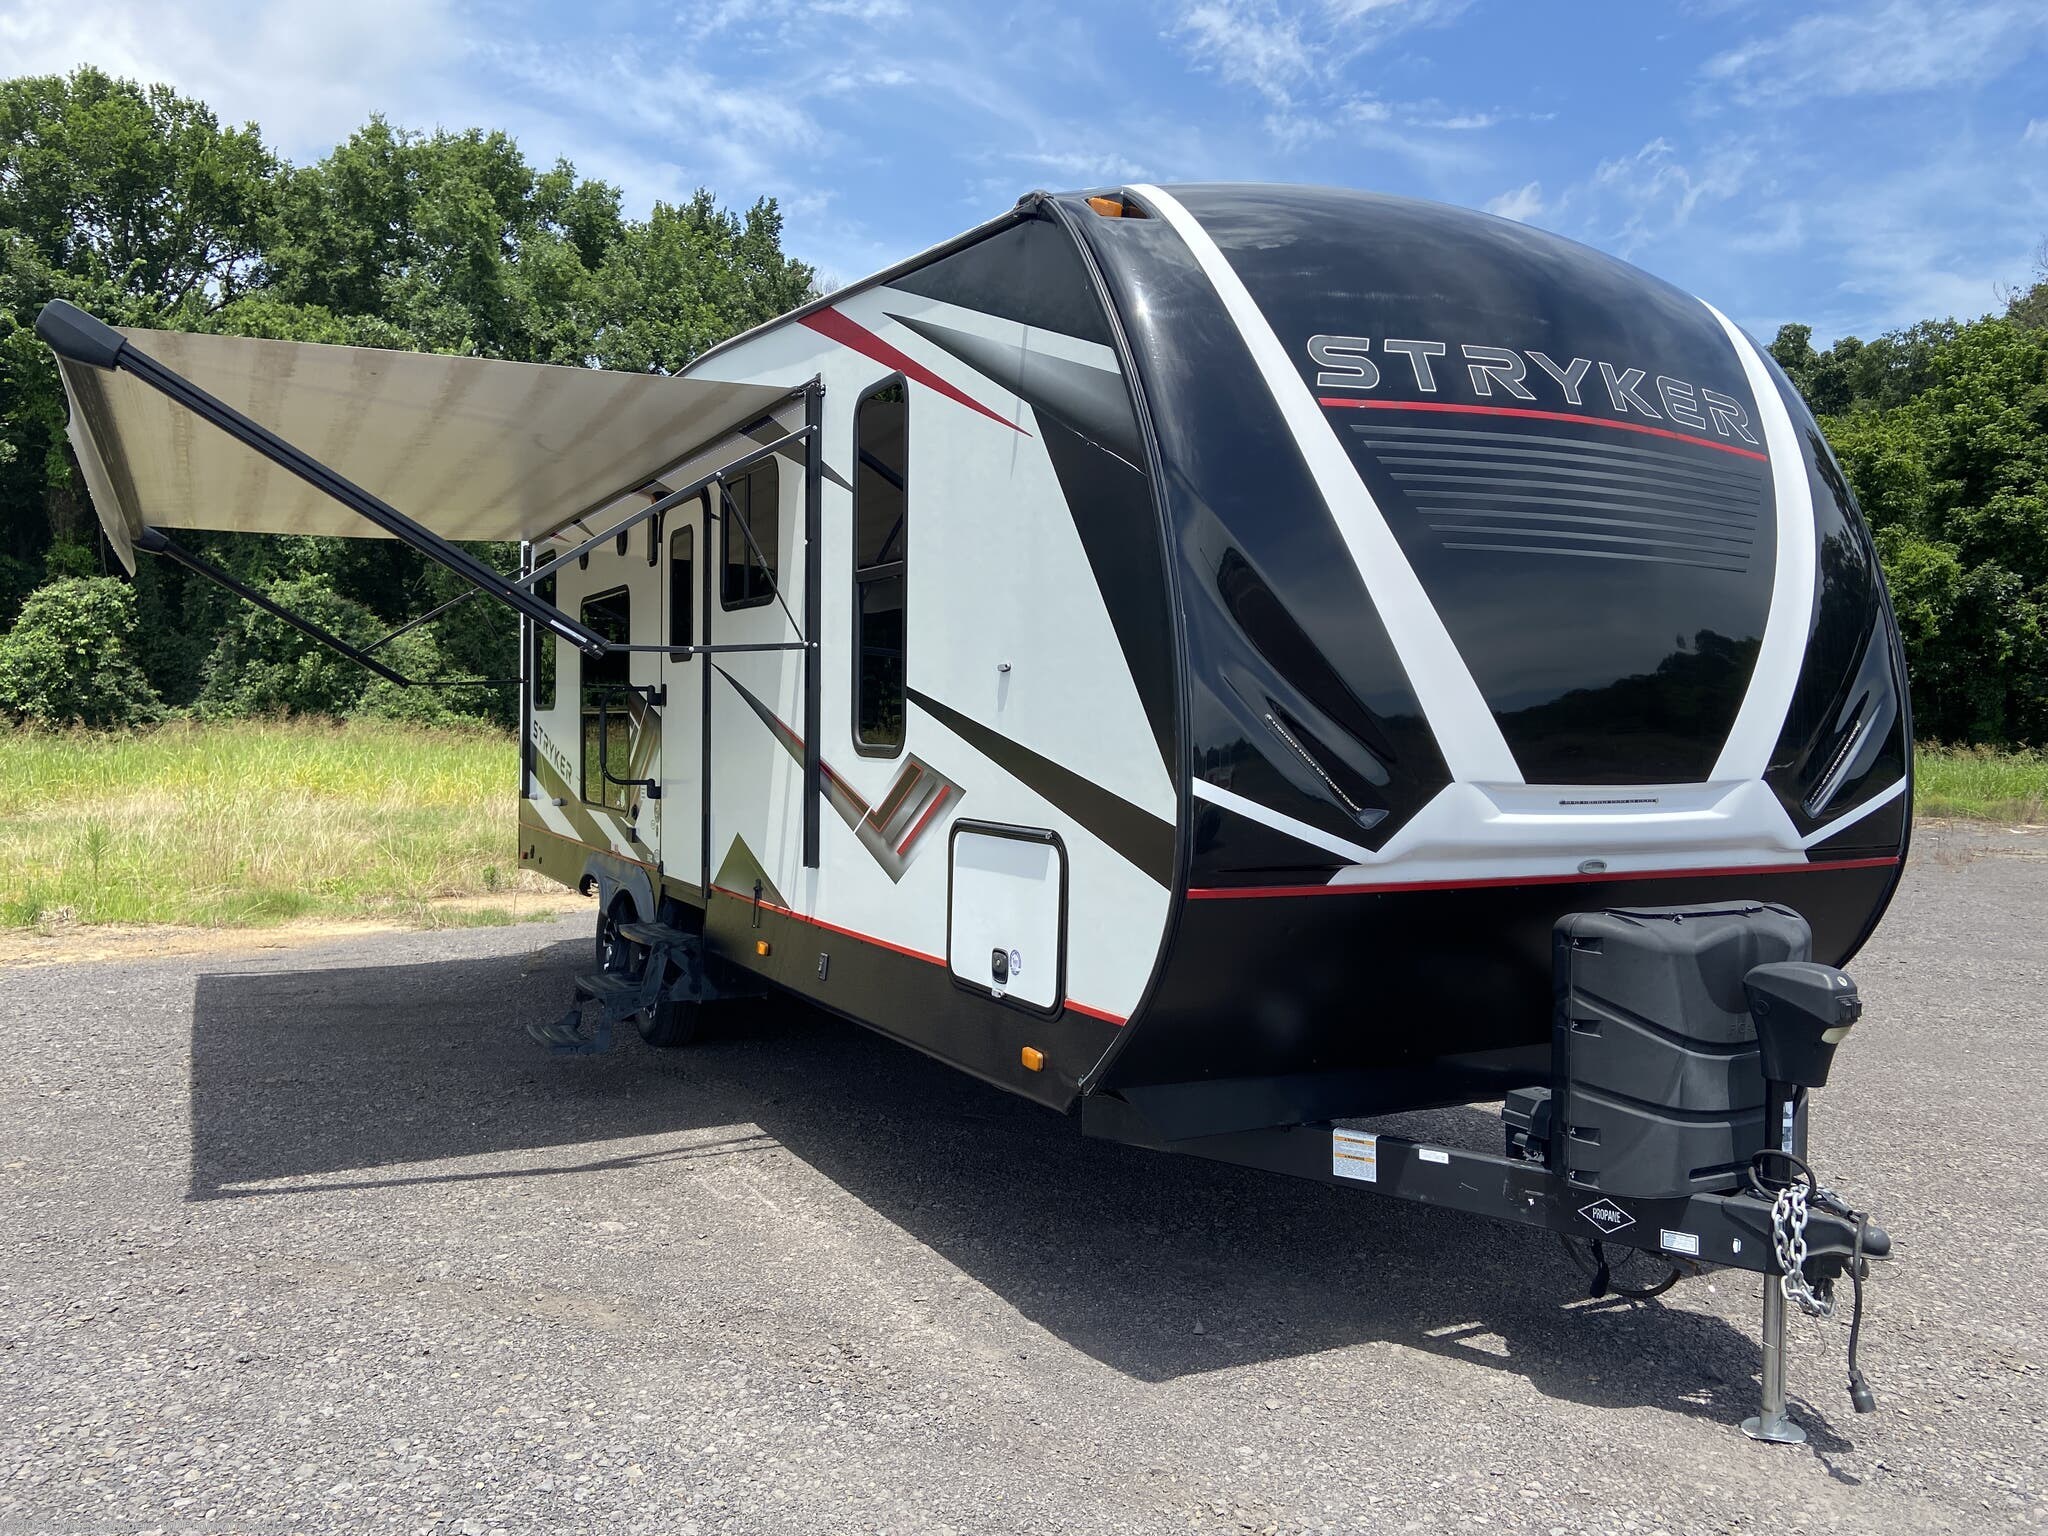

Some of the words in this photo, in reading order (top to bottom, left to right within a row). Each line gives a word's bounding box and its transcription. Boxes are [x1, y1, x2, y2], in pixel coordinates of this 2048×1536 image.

[1307, 334, 1760, 445] STRYKER
[533, 719, 572, 785] STRYKER
[1592, 1207, 1621, 1224] PROPANE
